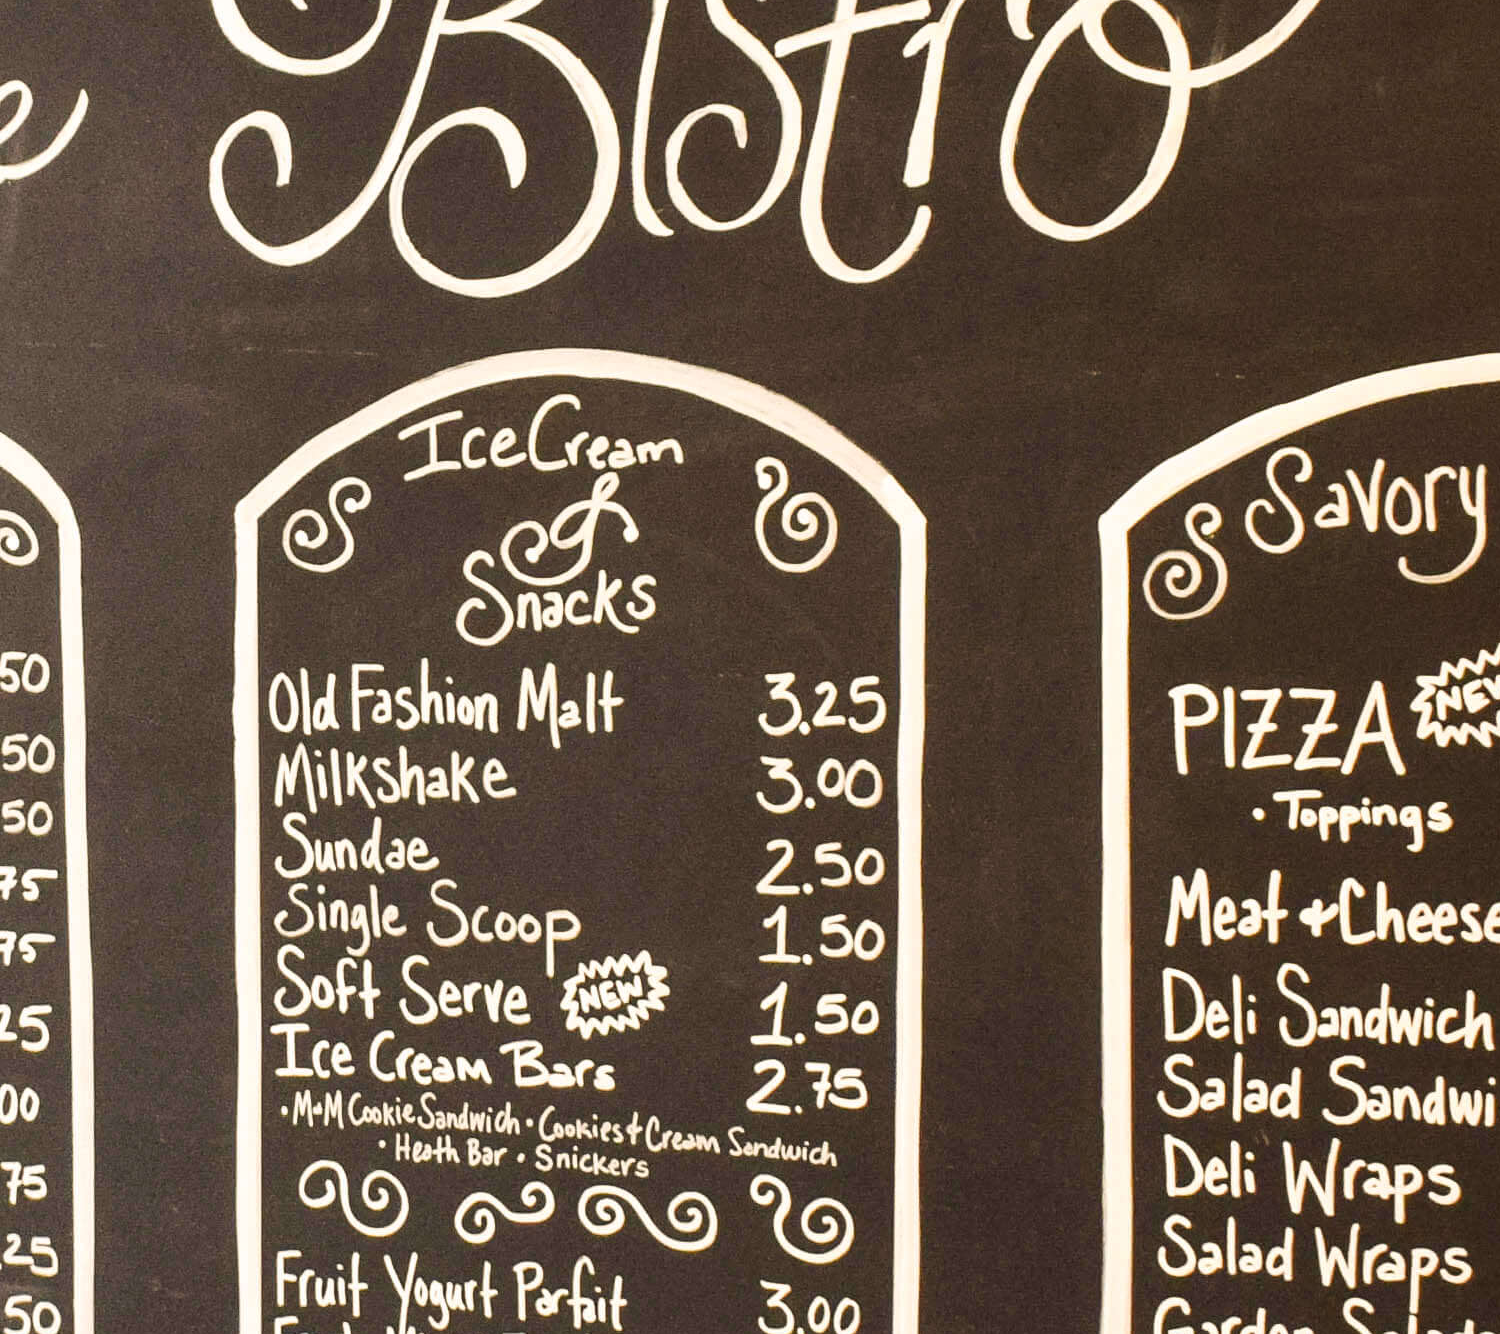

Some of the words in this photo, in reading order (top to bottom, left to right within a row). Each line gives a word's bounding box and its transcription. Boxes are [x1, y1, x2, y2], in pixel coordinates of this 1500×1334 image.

[1245, 447, 1486, 583] Savory
[455, 550, 658, 646] Snacks
[269, 668, 339, 735] Old
[352, 658, 498, 733] Fashion
[517, 663, 624, 749] Malt
[758, 673, 886, 736] 3.25
[1168, 681, 1406, 775] PIZZA
[275, 743, 516, 813] Milkshake
[757, 756, 882, 813] 3.00
[275, 812, 439, 878] Sundae
[756, 839, 884, 895] 2.50
[1273, 790, 1452, 852] Toppings
[274, 883, 407, 956] Single
[427, 879, 581, 978] Scoop
[759, 905, 885, 965] 1.50
[1165, 868, 1288, 947] Meat
[272, 942, 382, 1022] Soft
[399, 955, 531, 1024] Serve
[579, 975, 643, 1013] NEW
[751, 982, 879, 1046] 1.50
[1163, 968, 1256, 1044] Deli
[370, 1030, 492, 1085] Cream
[500, 1040, 615, 1091] Bars
[746, 1059, 867, 1115] 2.75
[1157, 1052, 1301, 1122] Salad
[348, 1092, 415, 1126] Cookie
[417, 1092, 520, 1134] Sandwich
[646, 1116, 720, 1153] Cream
[467, 1138, 507, 1166] Bar
[535, 1144, 649, 1177] Snickers
[1164, 1134, 1255, 1197] Deli
[1283, 1138, 1460, 1224] Wraps
[277, 1250, 368, 1317] Fruit
[1158, 1214, 1293, 1281] Salad
[1315, 1223, 1474, 1314] Wraps
